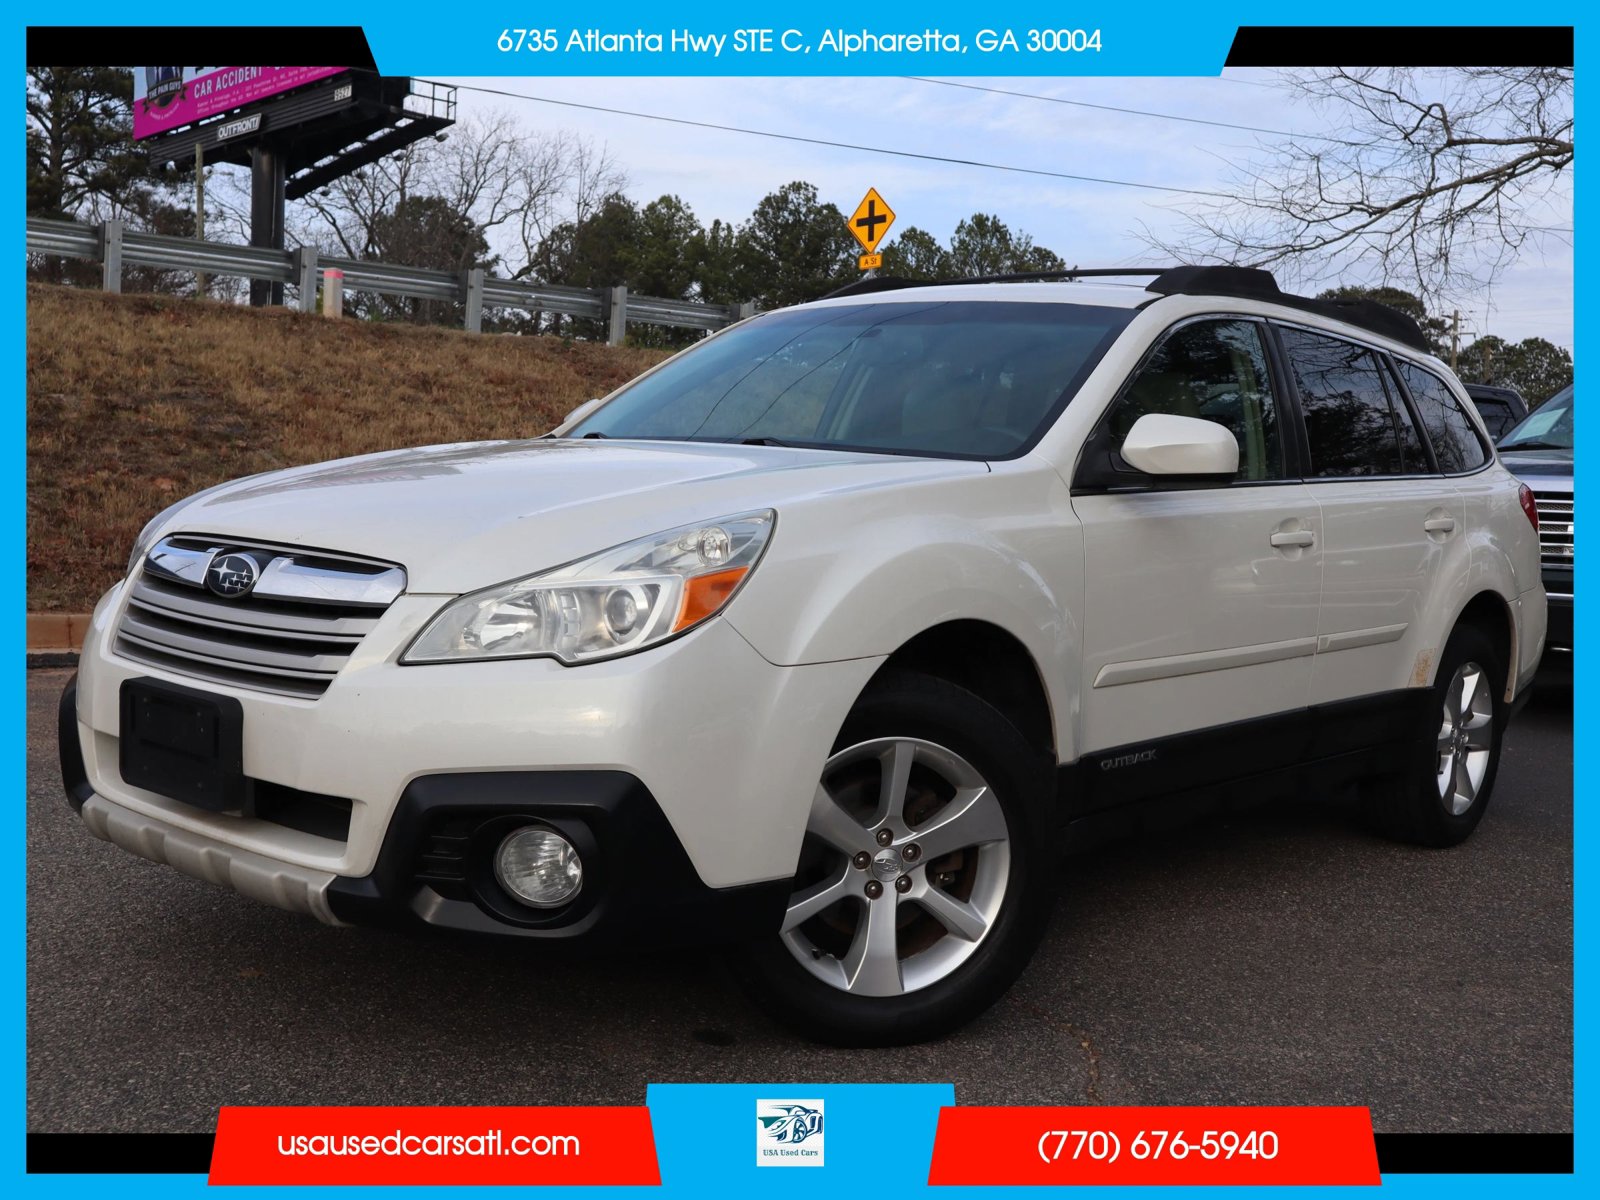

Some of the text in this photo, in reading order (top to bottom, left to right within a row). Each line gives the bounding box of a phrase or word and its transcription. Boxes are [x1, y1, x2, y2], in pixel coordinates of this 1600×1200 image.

[194, 79, 213, 99] CAR
[215, 66, 262, 90] ACCIDENT
[1101, 749, 1156, 771] OUTBACK
